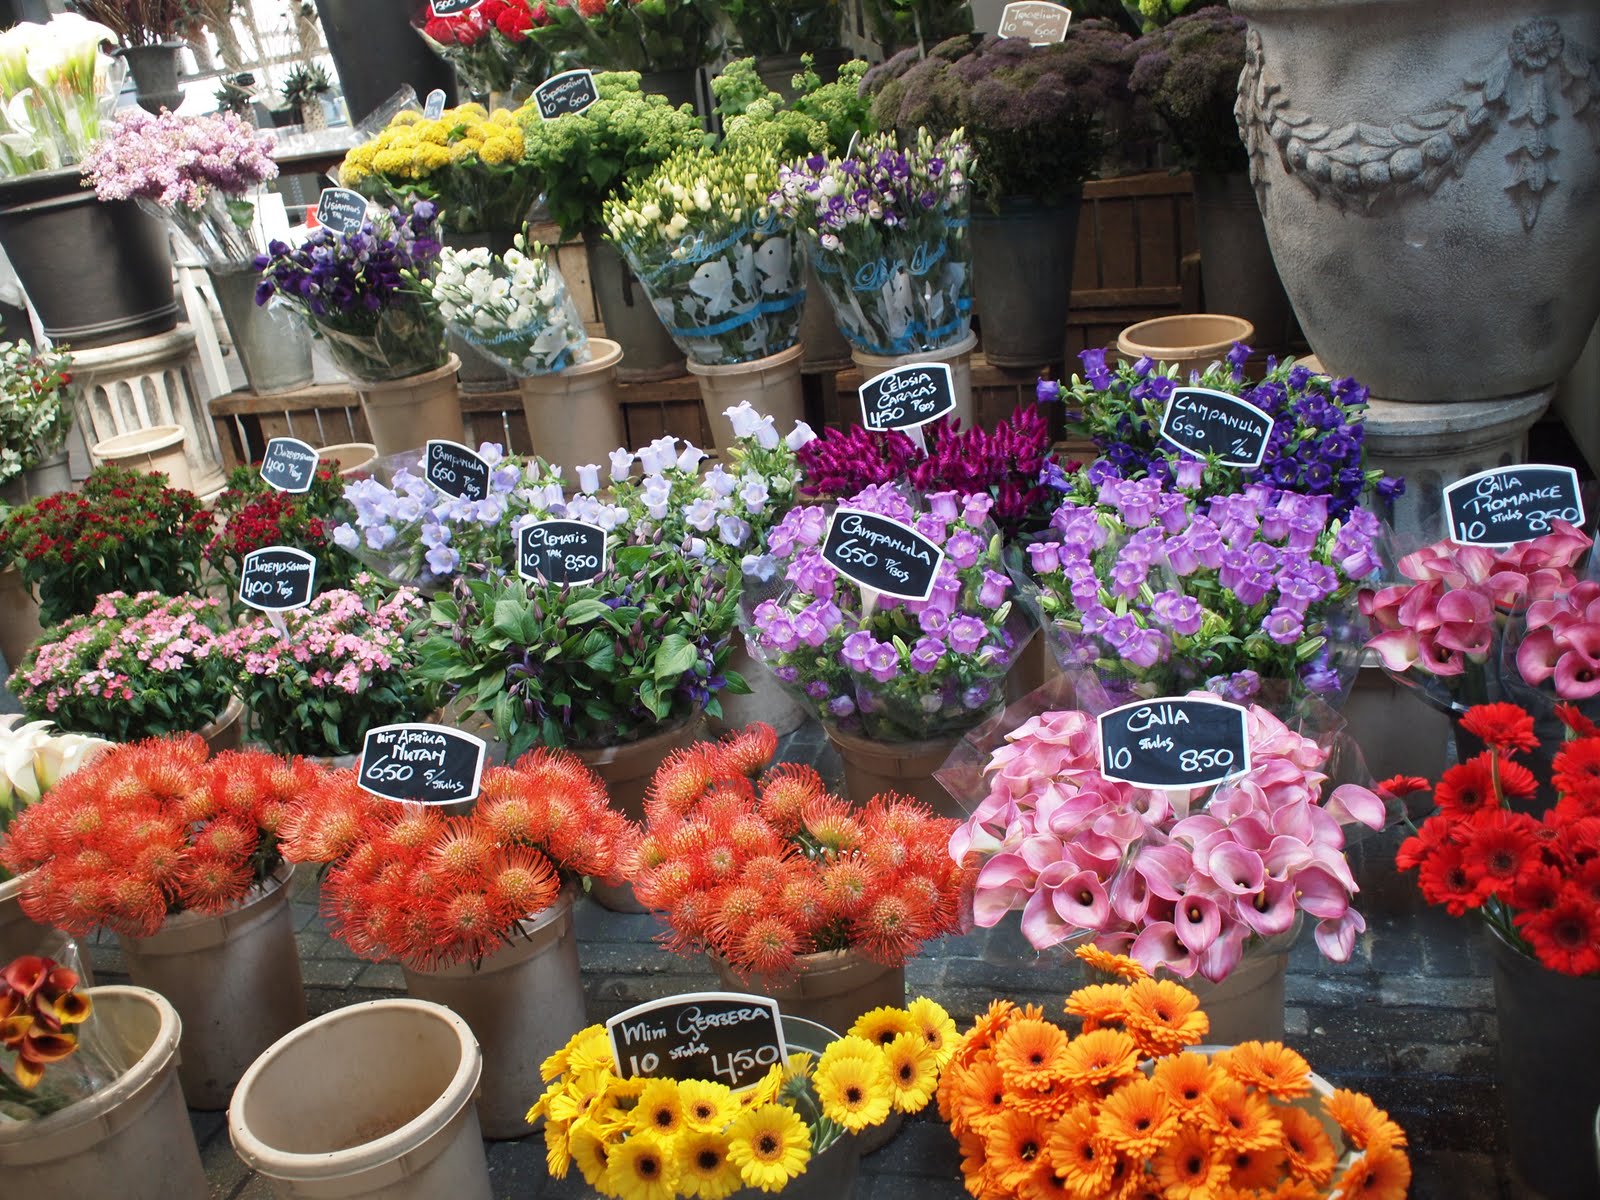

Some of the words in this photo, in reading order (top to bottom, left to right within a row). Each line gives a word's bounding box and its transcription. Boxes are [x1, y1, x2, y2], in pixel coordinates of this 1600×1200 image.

[1004, 21, 1017, 32] 10
[543, 102, 557, 115] 10
[877, 382, 937, 409] CARACAS
[870, 407, 905, 428] 4.50
[1459, 520, 1486, 541] 10
[524, 553, 540, 567] 10
[564, 554, 598, 572] 8.50
[835, 538, 878, 567] 6.50
[245, 577, 272, 598] 4.00
[366, 754, 414, 782] 6.50
[1107, 745, 1132, 769] 10
[1179, 748, 1234, 772] 8.50
[629, 1053, 660, 1077] 10
[711, 1044, 780, 1084] 4.50
